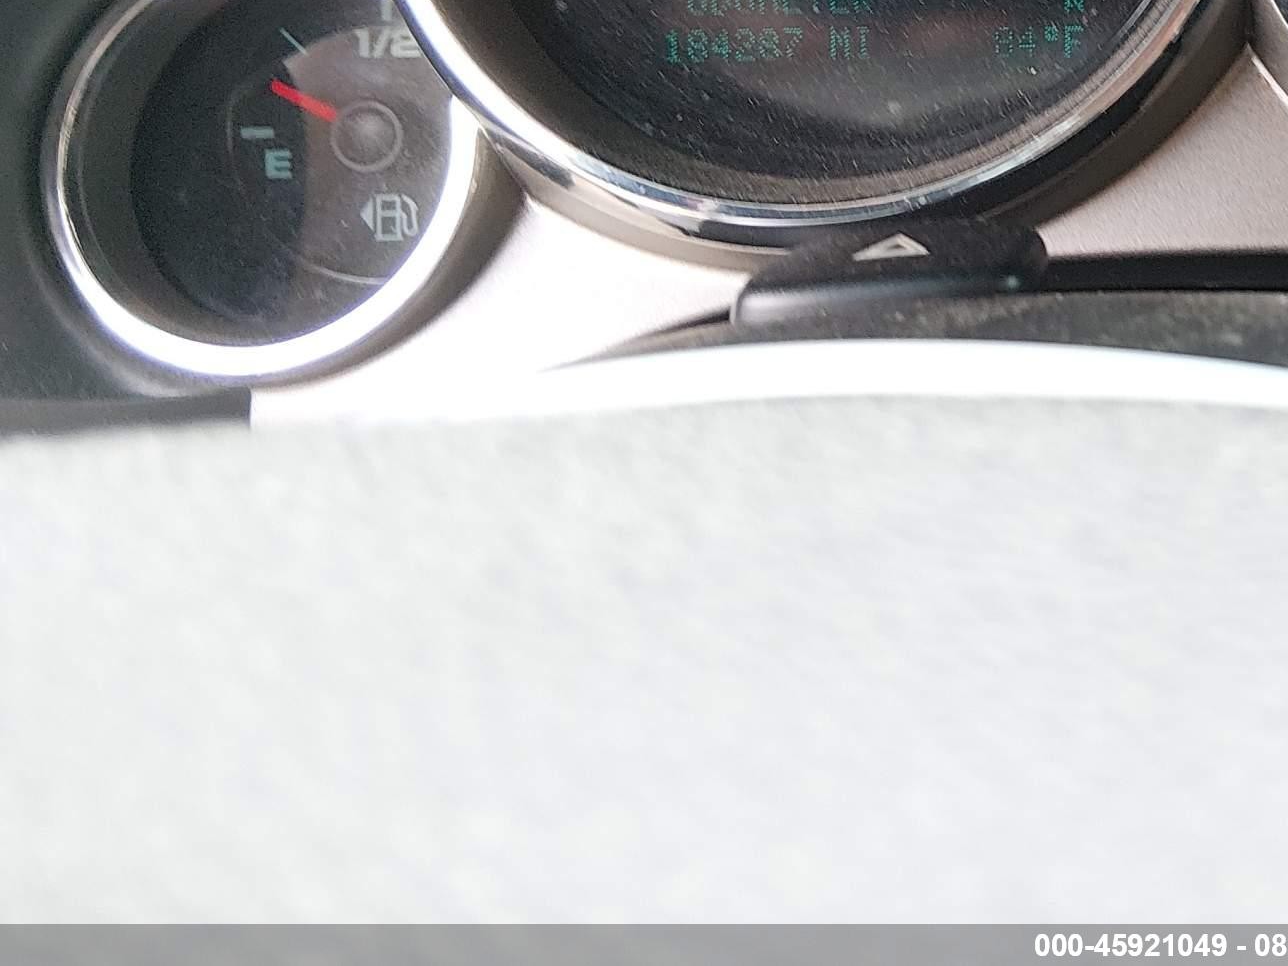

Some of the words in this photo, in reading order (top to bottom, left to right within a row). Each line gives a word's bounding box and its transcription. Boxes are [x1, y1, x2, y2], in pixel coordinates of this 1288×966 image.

[352, 26, 423, 59] 1/2
[829, 26, 870, 61] MI
[265, 148, 292, 179] E
